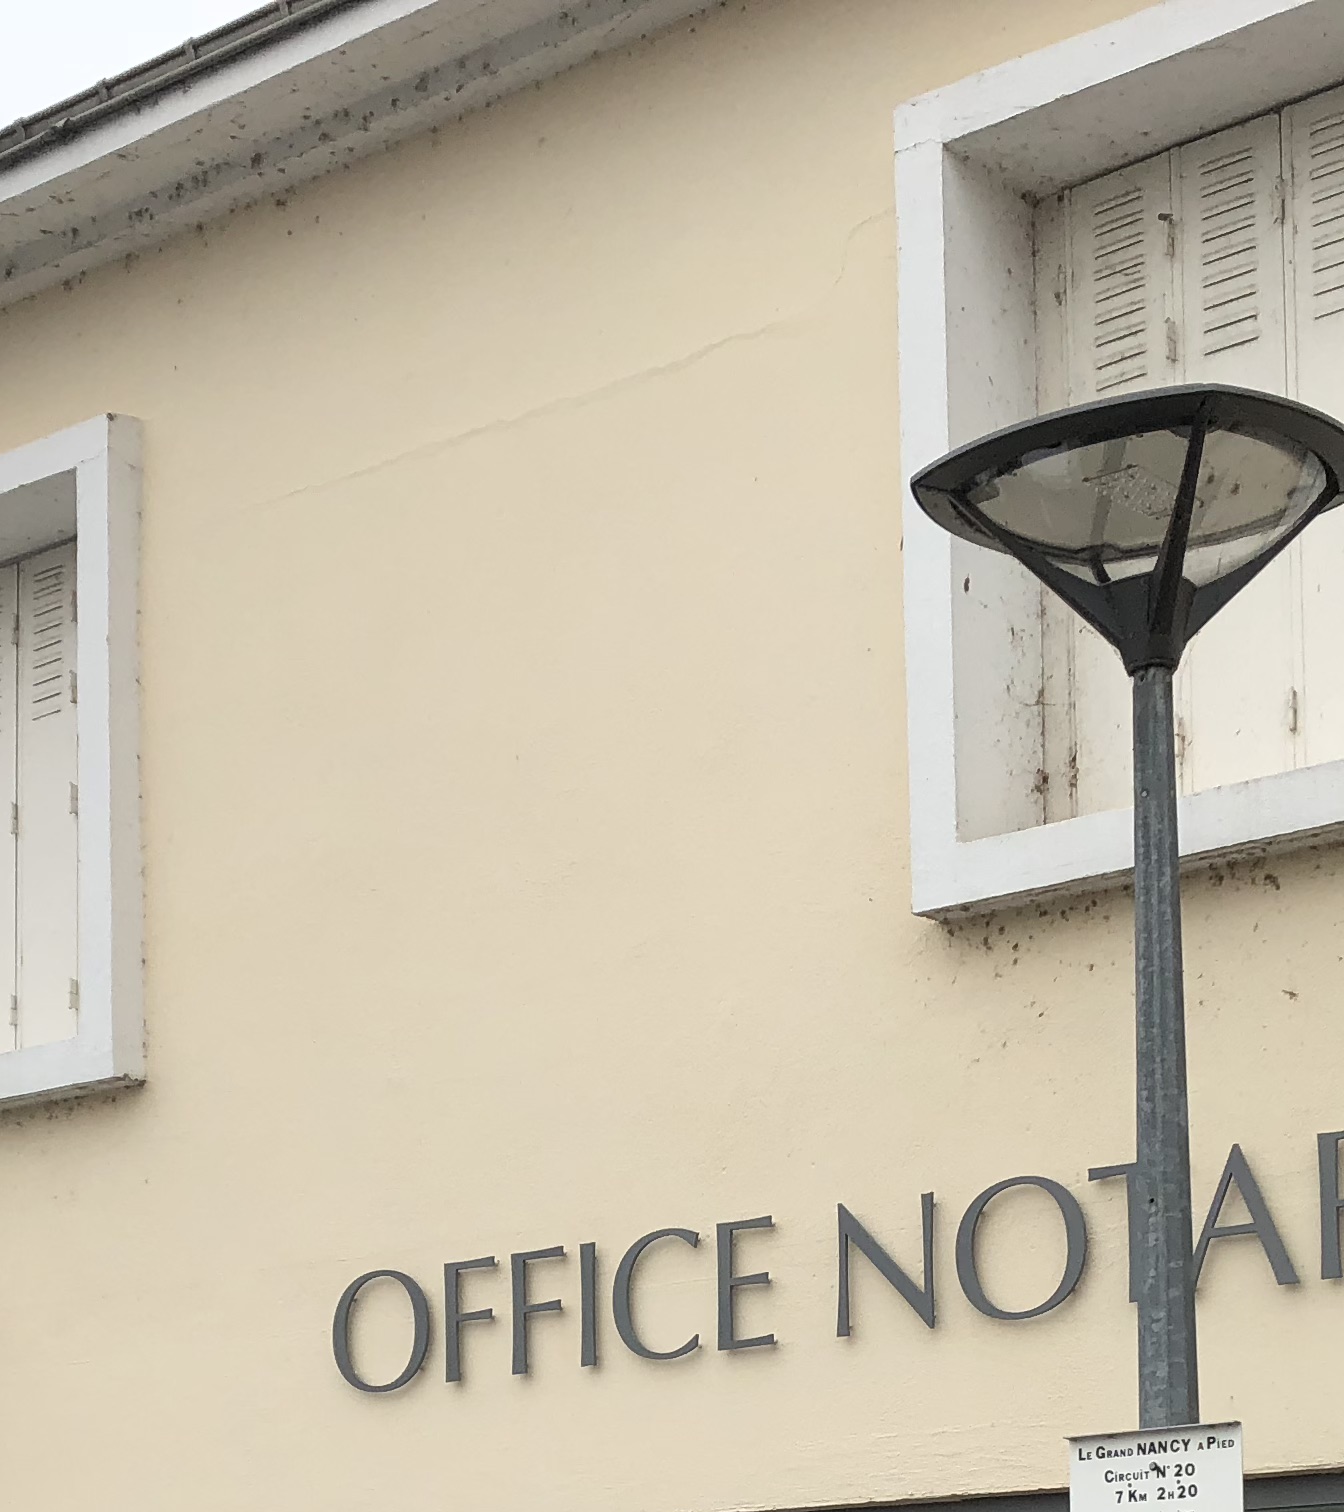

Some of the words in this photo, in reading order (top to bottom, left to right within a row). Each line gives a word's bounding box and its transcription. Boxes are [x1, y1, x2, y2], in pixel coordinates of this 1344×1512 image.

[332, 1215, 776, 1393] OFFICE
[1136, 1438, 1191, 1456] NANCY
[1174, 1463, 1196, 1477] 20
[1115, 1490, 1123, 1503] 7
